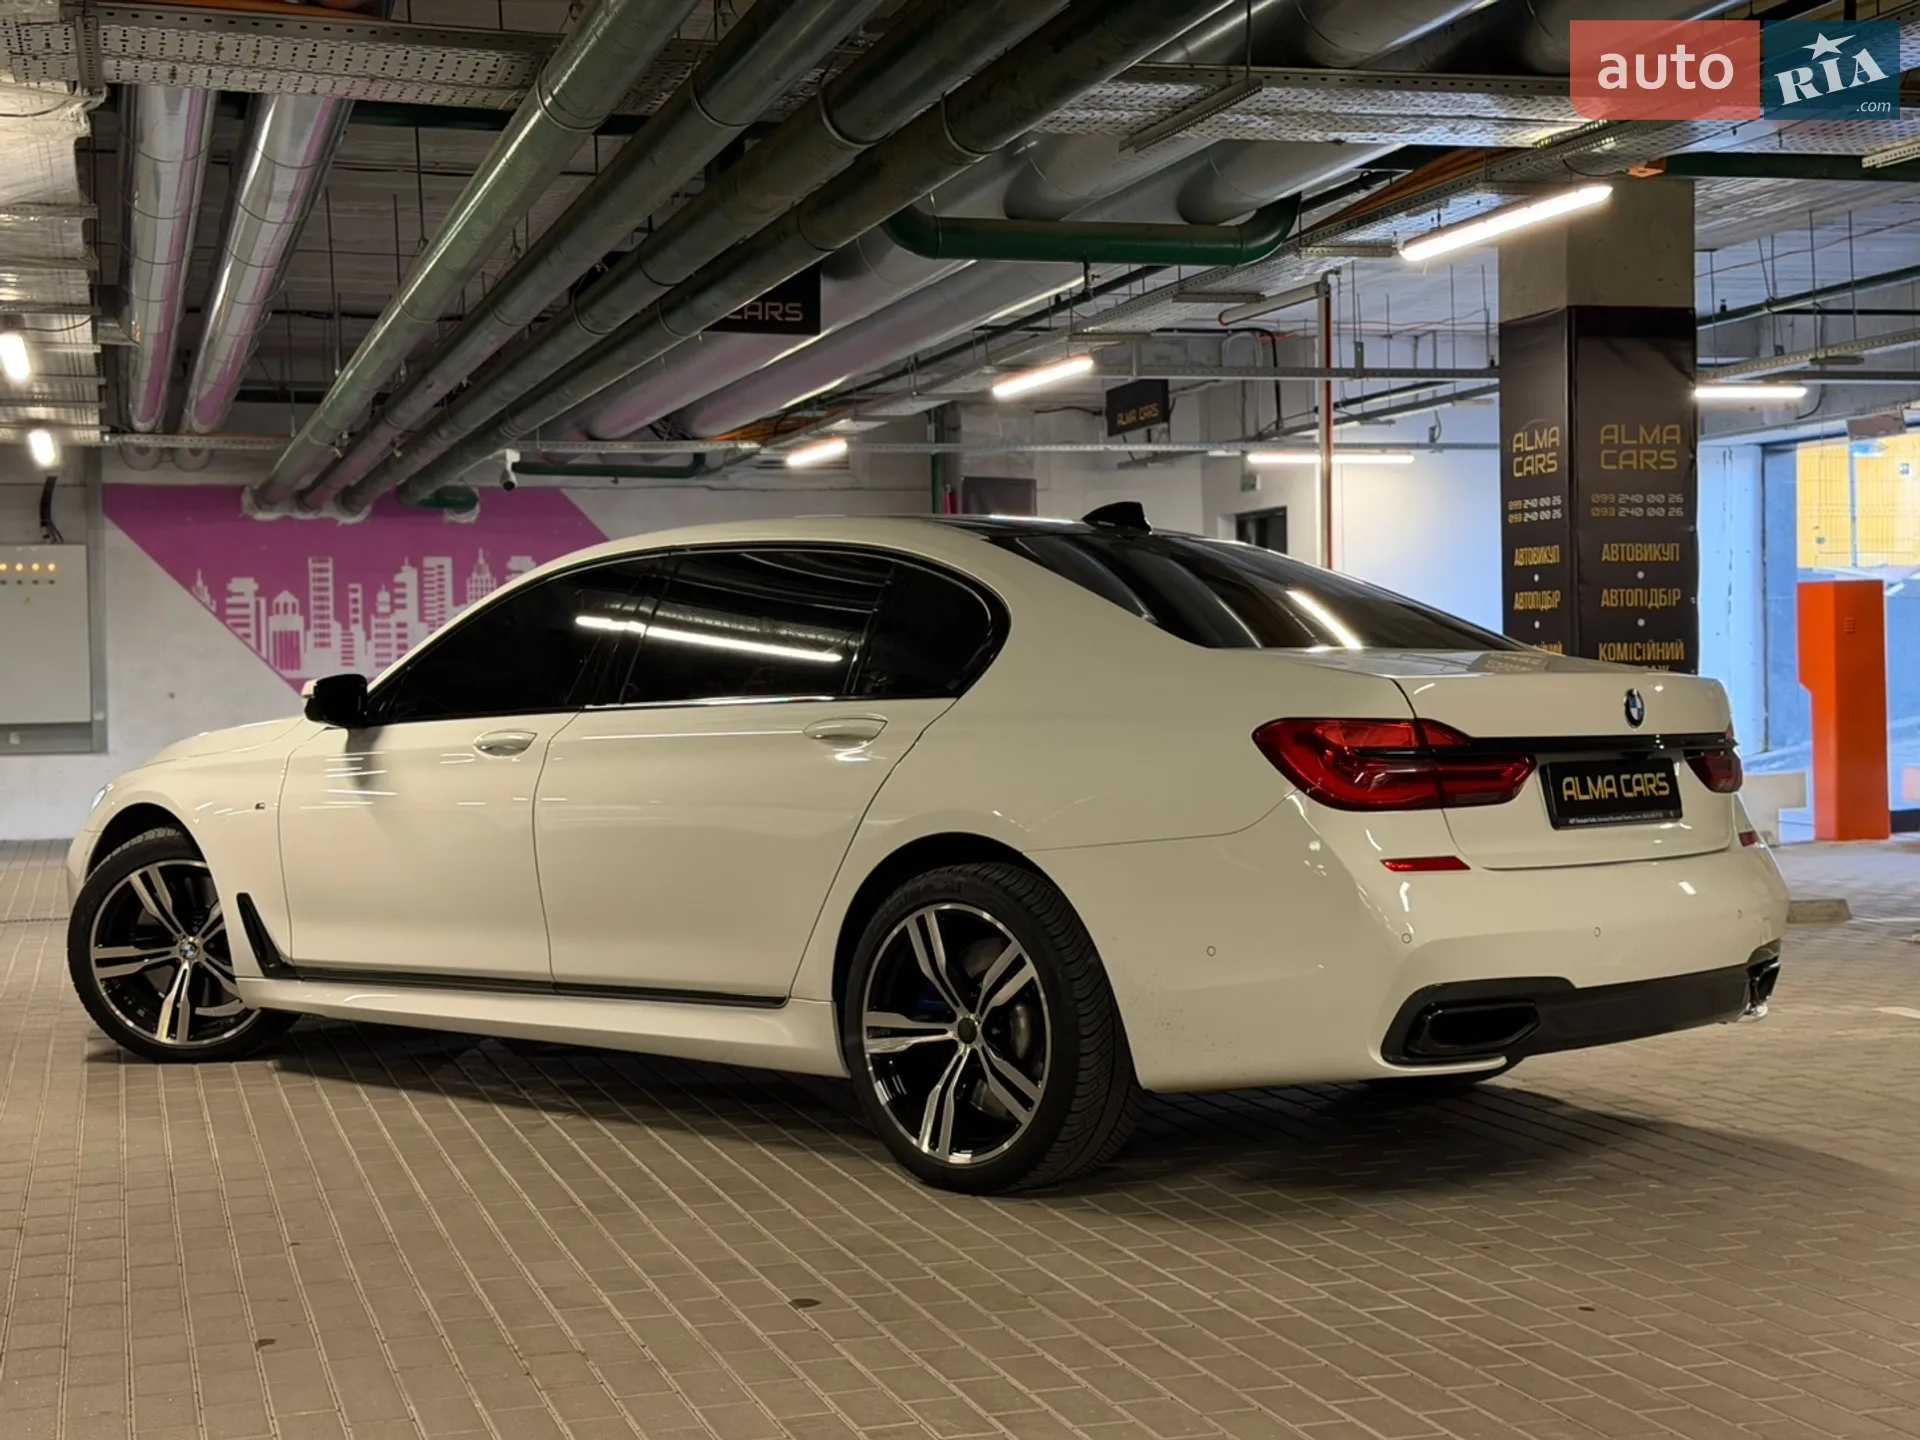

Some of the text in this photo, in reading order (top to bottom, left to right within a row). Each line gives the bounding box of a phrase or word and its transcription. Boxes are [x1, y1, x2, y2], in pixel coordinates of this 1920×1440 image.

[1512, 426, 1560, 453] ALMA
[1600, 424, 1682, 445] ALMA
[1513, 451, 1558, 478] CARS
[1600, 449, 1678, 471] CARS
[1591, 493, 1684, 504] 099 240 00 26
[1618, 506, 1644, 517] 240
[1646, 506, 1666, 517] 00
[1668, 506, 1684, 517] 26
[1514, 545, 1560, 566] АВТОВИКУП
[1602, 543, 1680, 562] АВТОВИКУП
[1514, 590, 1561, 611] АВТОПІДБІР
[1601, 588, 1681, 609] АВТОПІДБІР
[1599, 640, 1684, 662] КОМІСІЙНИЙ
[1562, 772, 1670, 801] ALMA CARS
